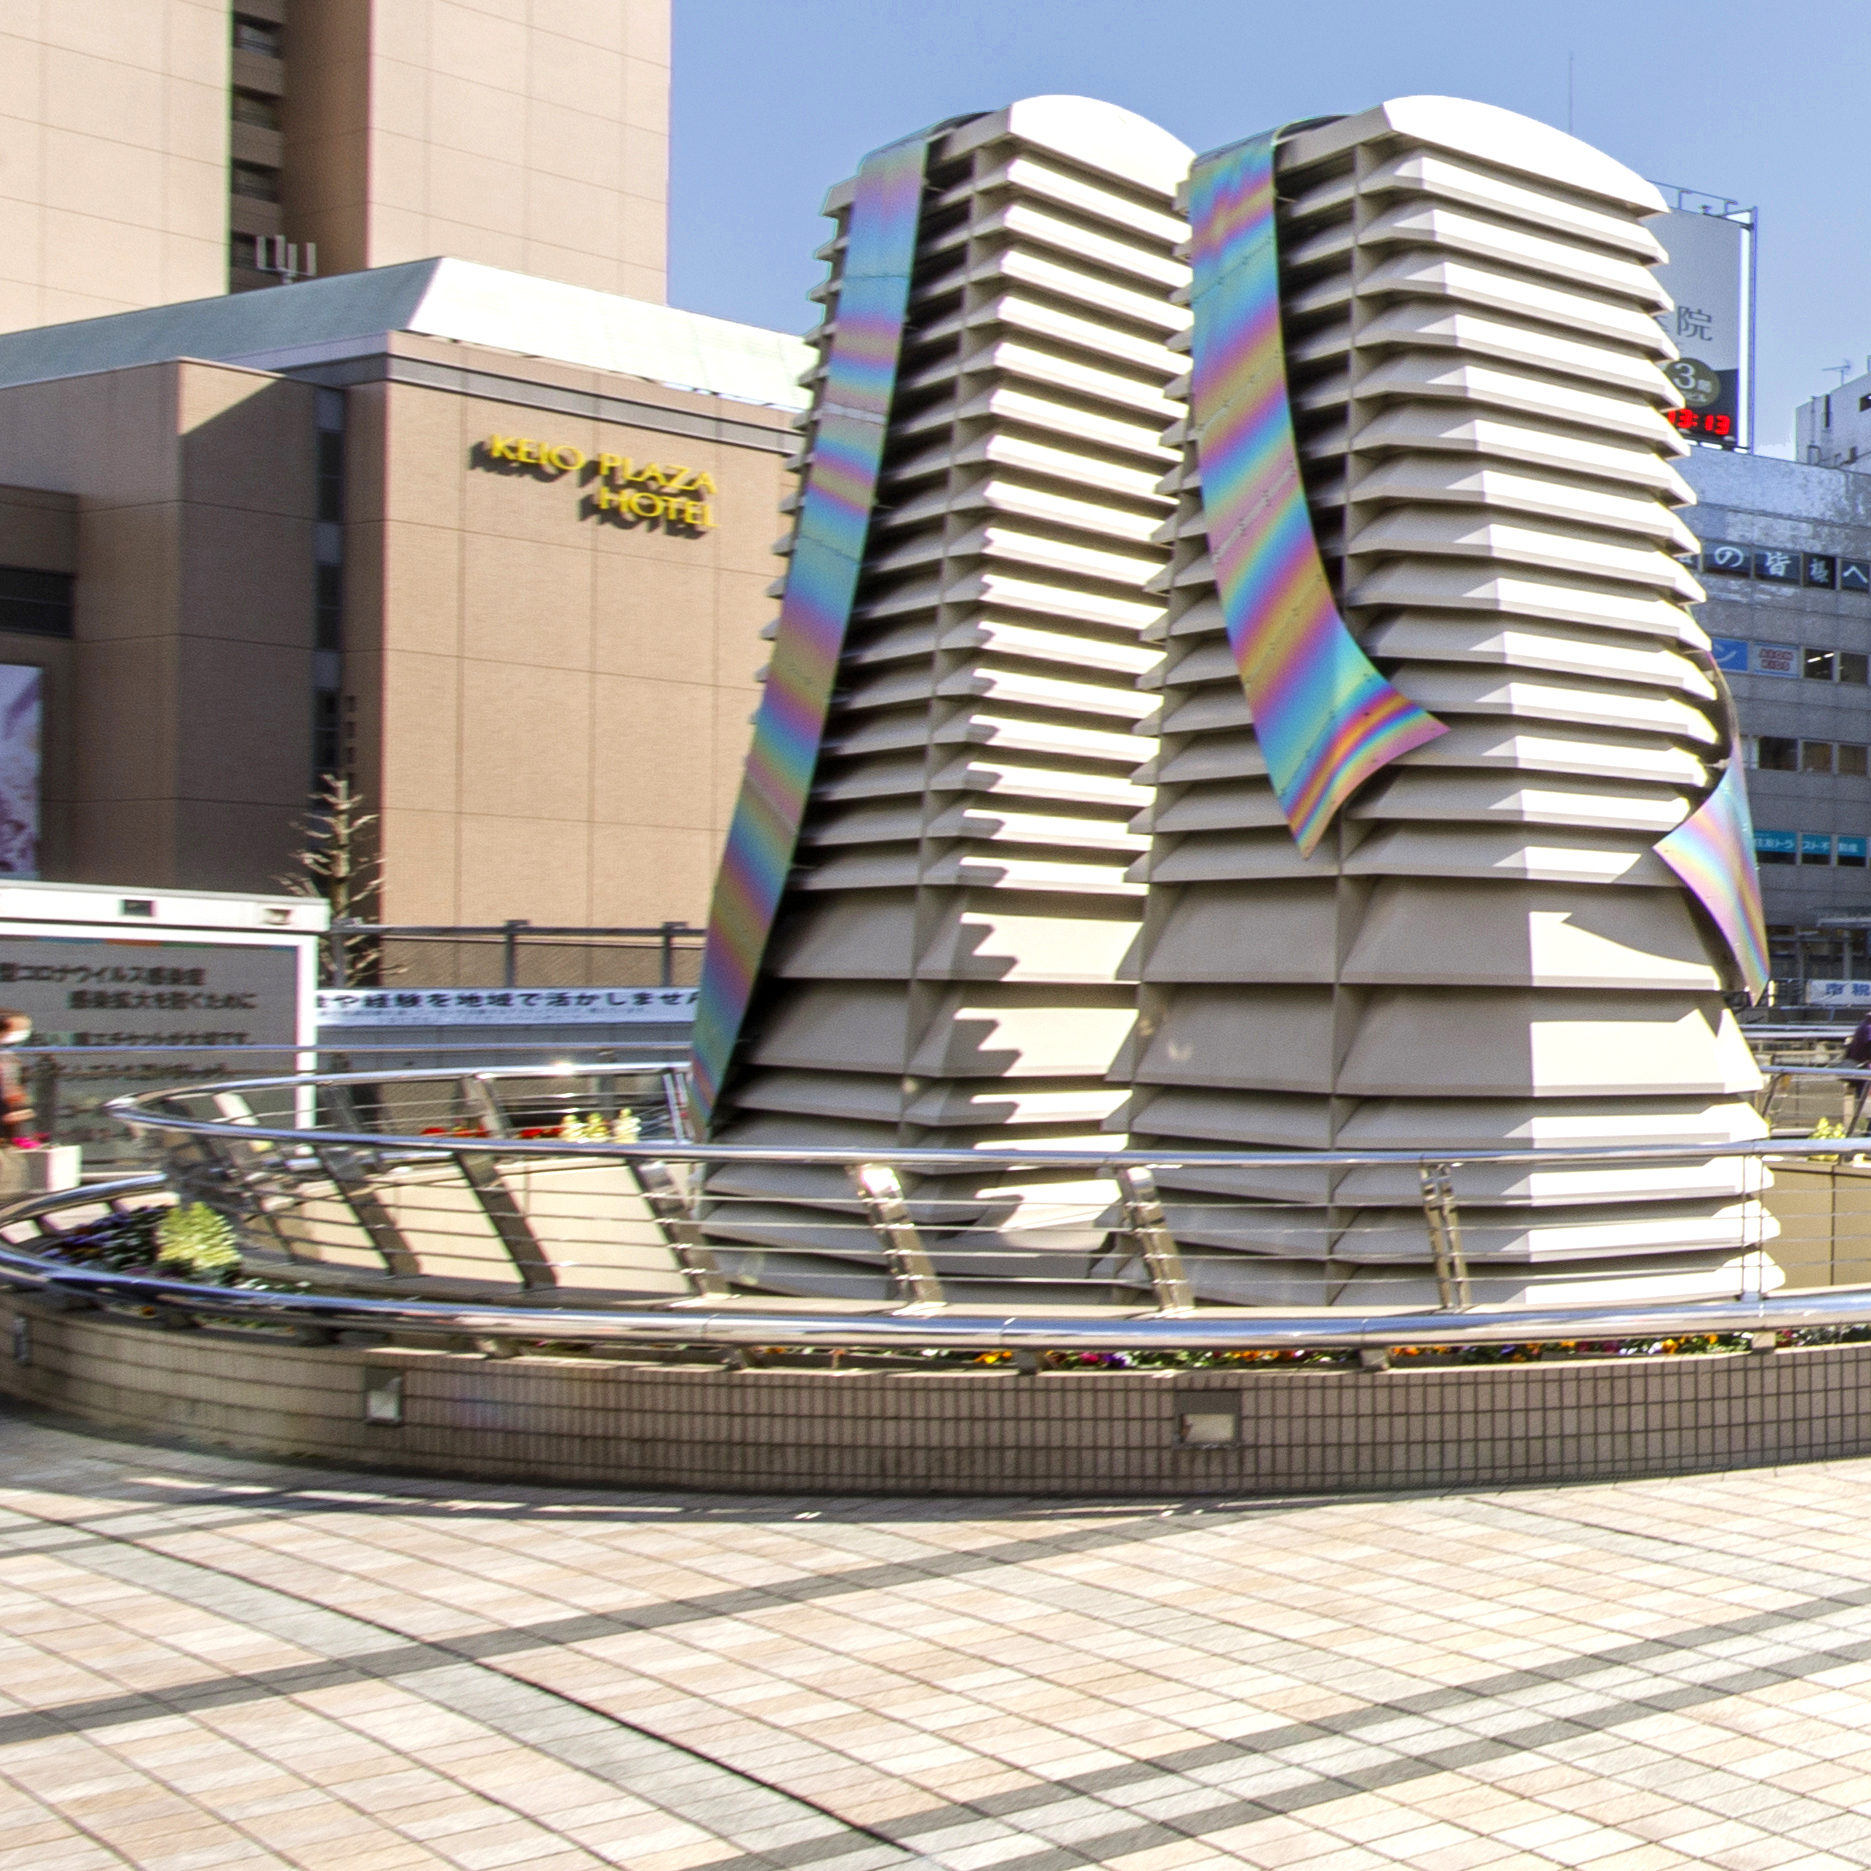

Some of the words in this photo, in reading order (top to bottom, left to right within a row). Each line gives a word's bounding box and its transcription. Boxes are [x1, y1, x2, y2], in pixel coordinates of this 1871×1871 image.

[490, 434, 587, 471] KEIO
[599, 452, 718, 495] PLAZA
[599, 485, 720, 528] HOTEL
